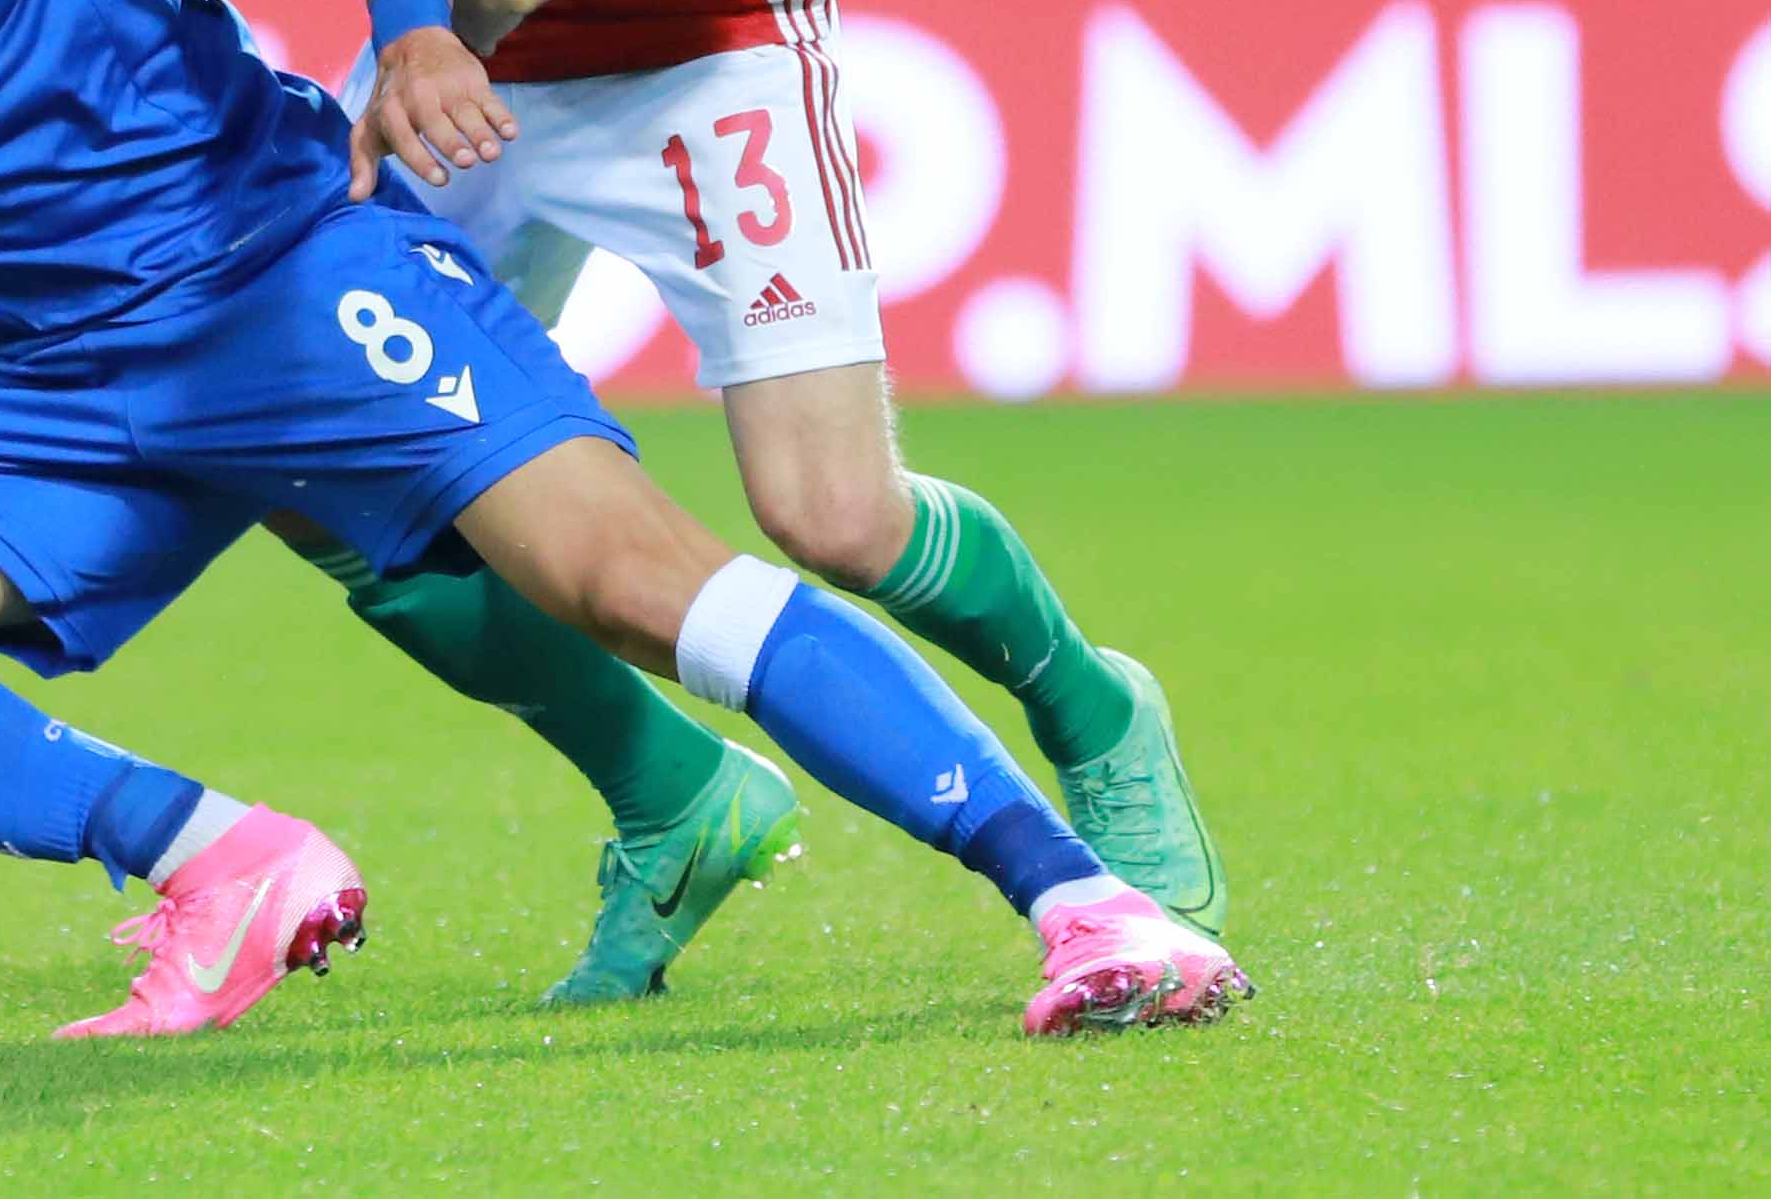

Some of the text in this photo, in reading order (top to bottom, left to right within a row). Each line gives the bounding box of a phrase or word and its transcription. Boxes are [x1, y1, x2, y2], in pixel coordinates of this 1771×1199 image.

[661, 108, 794, 269] 13
[337, 290, 433, 384] 8
[744, 300, 816, 327] adidas
